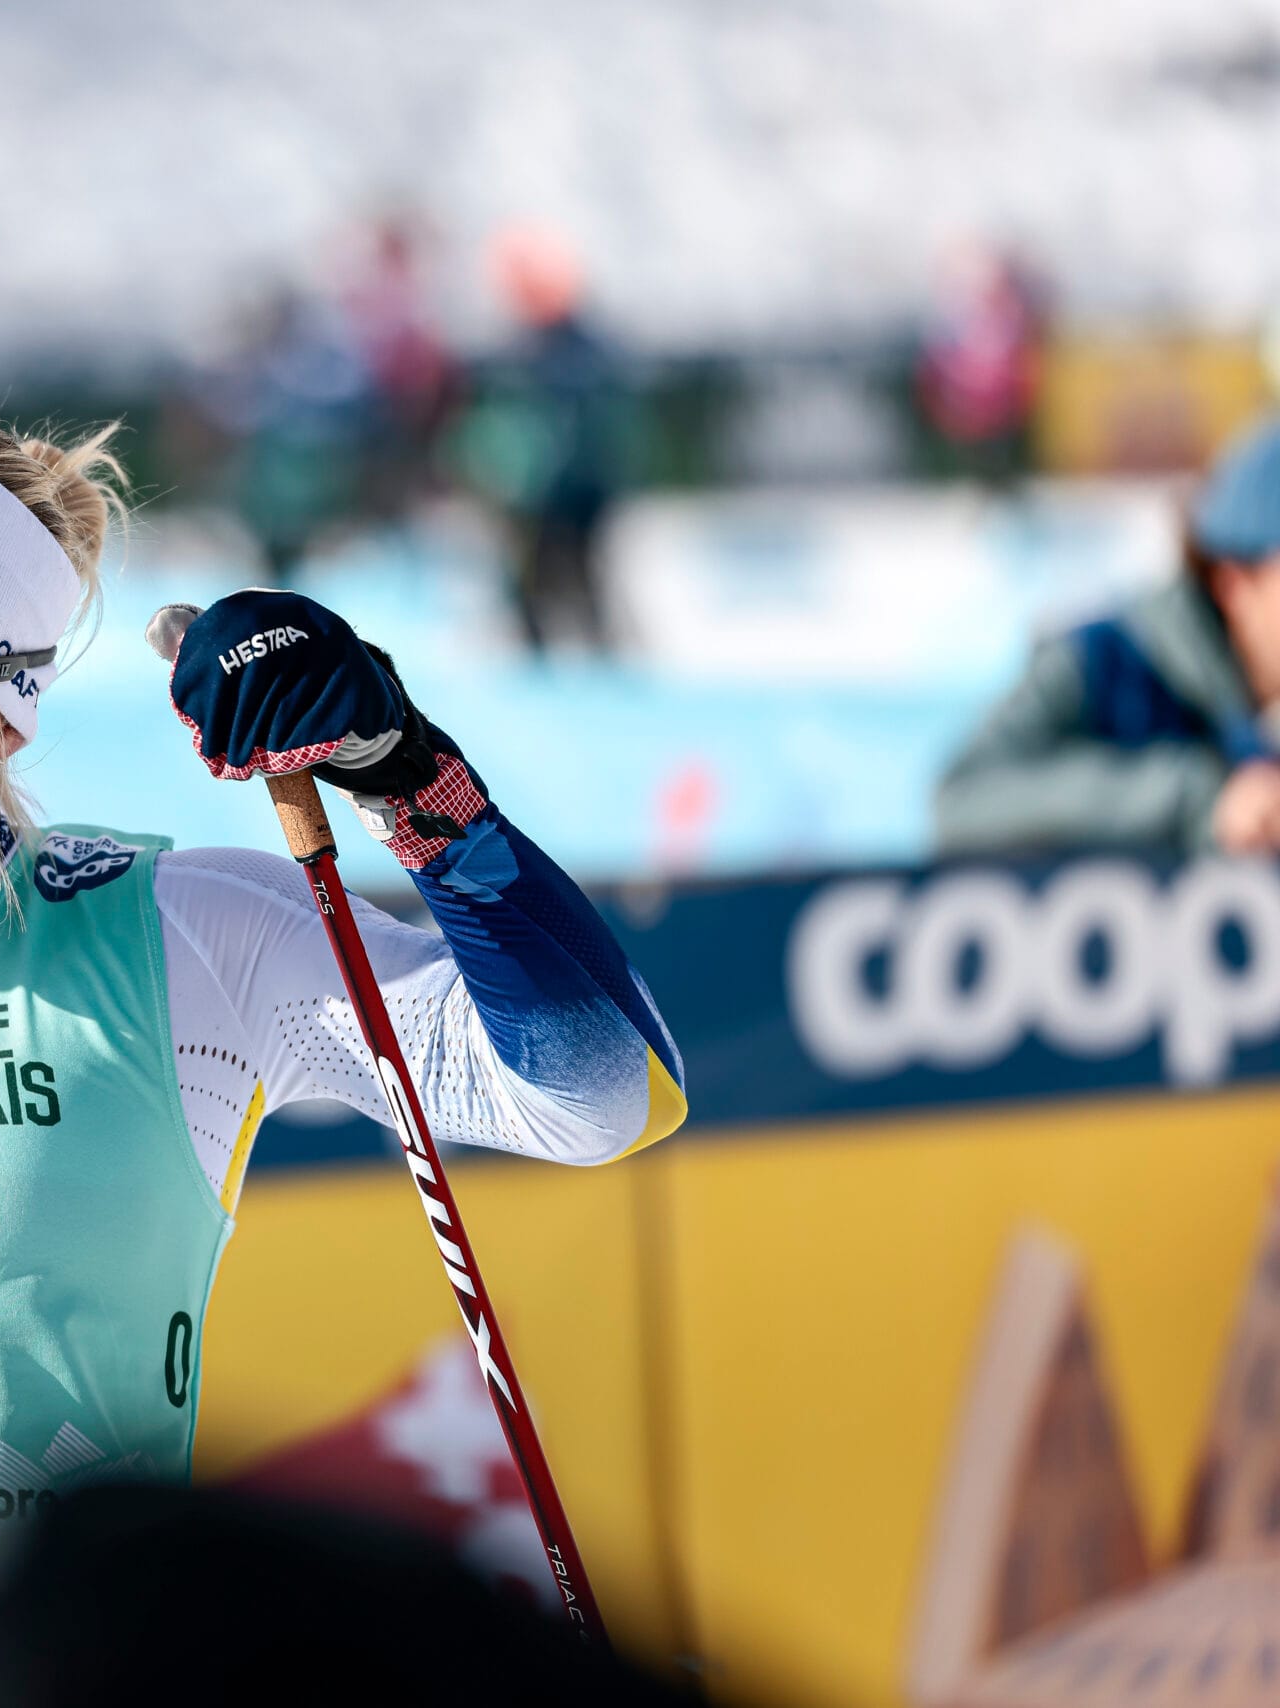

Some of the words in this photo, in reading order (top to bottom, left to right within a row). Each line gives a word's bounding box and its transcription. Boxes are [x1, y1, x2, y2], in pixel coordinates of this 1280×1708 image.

[218, 625, 310, 675] HESTRA
[40, 856, 130, 889] coop
[312, 880, 335, 915] TCS
[784, 858, 1280, 1086] coop
